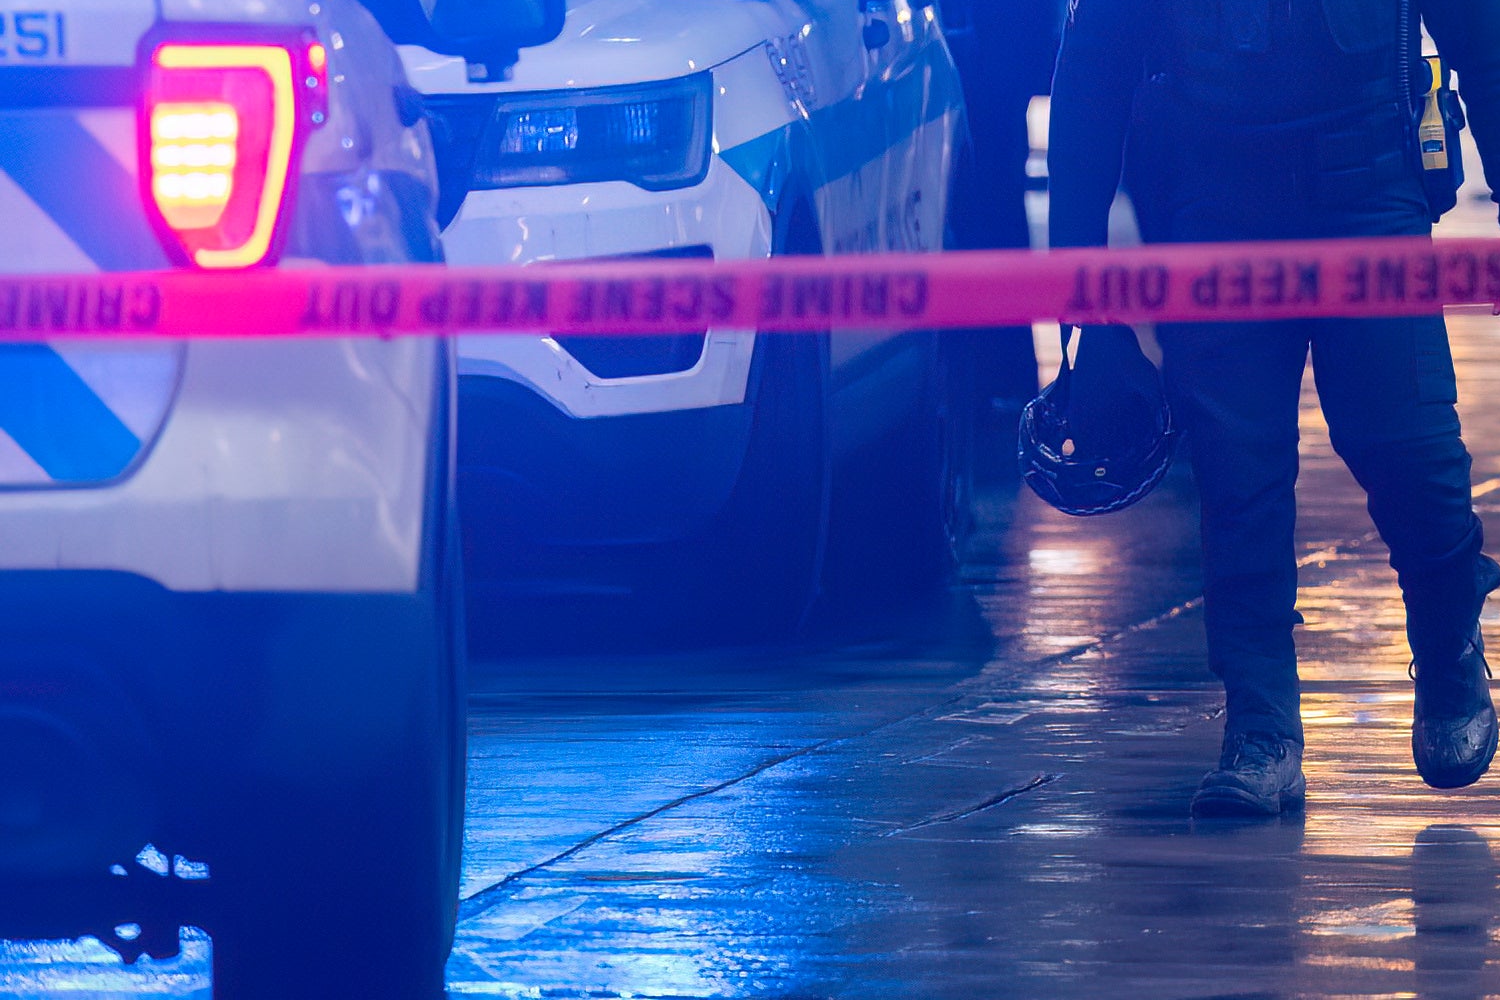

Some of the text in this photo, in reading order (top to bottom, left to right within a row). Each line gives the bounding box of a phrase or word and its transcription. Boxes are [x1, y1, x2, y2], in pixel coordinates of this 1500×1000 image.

[300, 280, 399, 329] OUT
[419, 277, 548, 325] KEEP
[567, 273, 736, 323] SCENE
[760, 271, 929, 319] CRIME
[1066, 264, 1169, 314] OUT
[1191, 257, 1319, 306] KEEP
